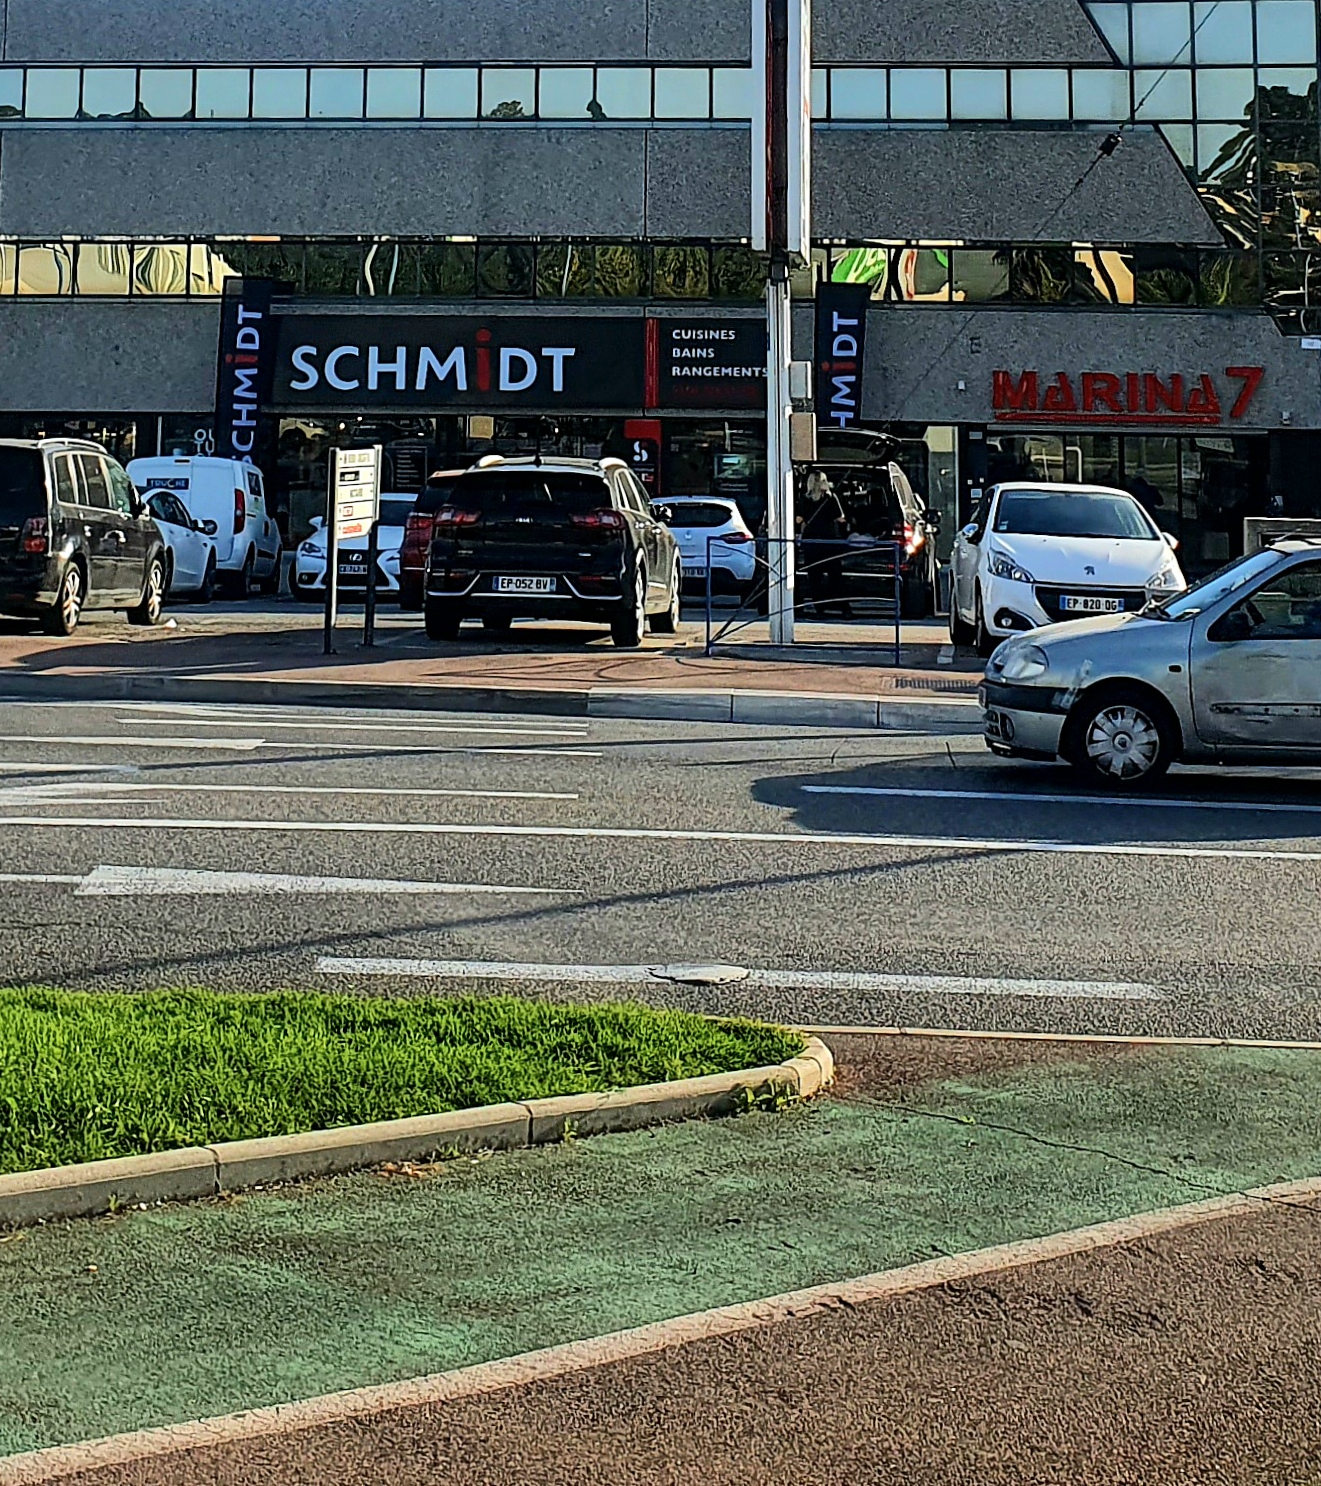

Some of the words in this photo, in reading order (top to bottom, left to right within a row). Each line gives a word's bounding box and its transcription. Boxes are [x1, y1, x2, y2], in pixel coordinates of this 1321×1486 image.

[672, 329, 736, 340] CUISINES
[672, 348, 715, 358] BAINS
[671, 366, 768, 377] RANGEMENTS
[992, 369, 1221, 412] MARINA
[1225, 365, 1264, 418] 7
